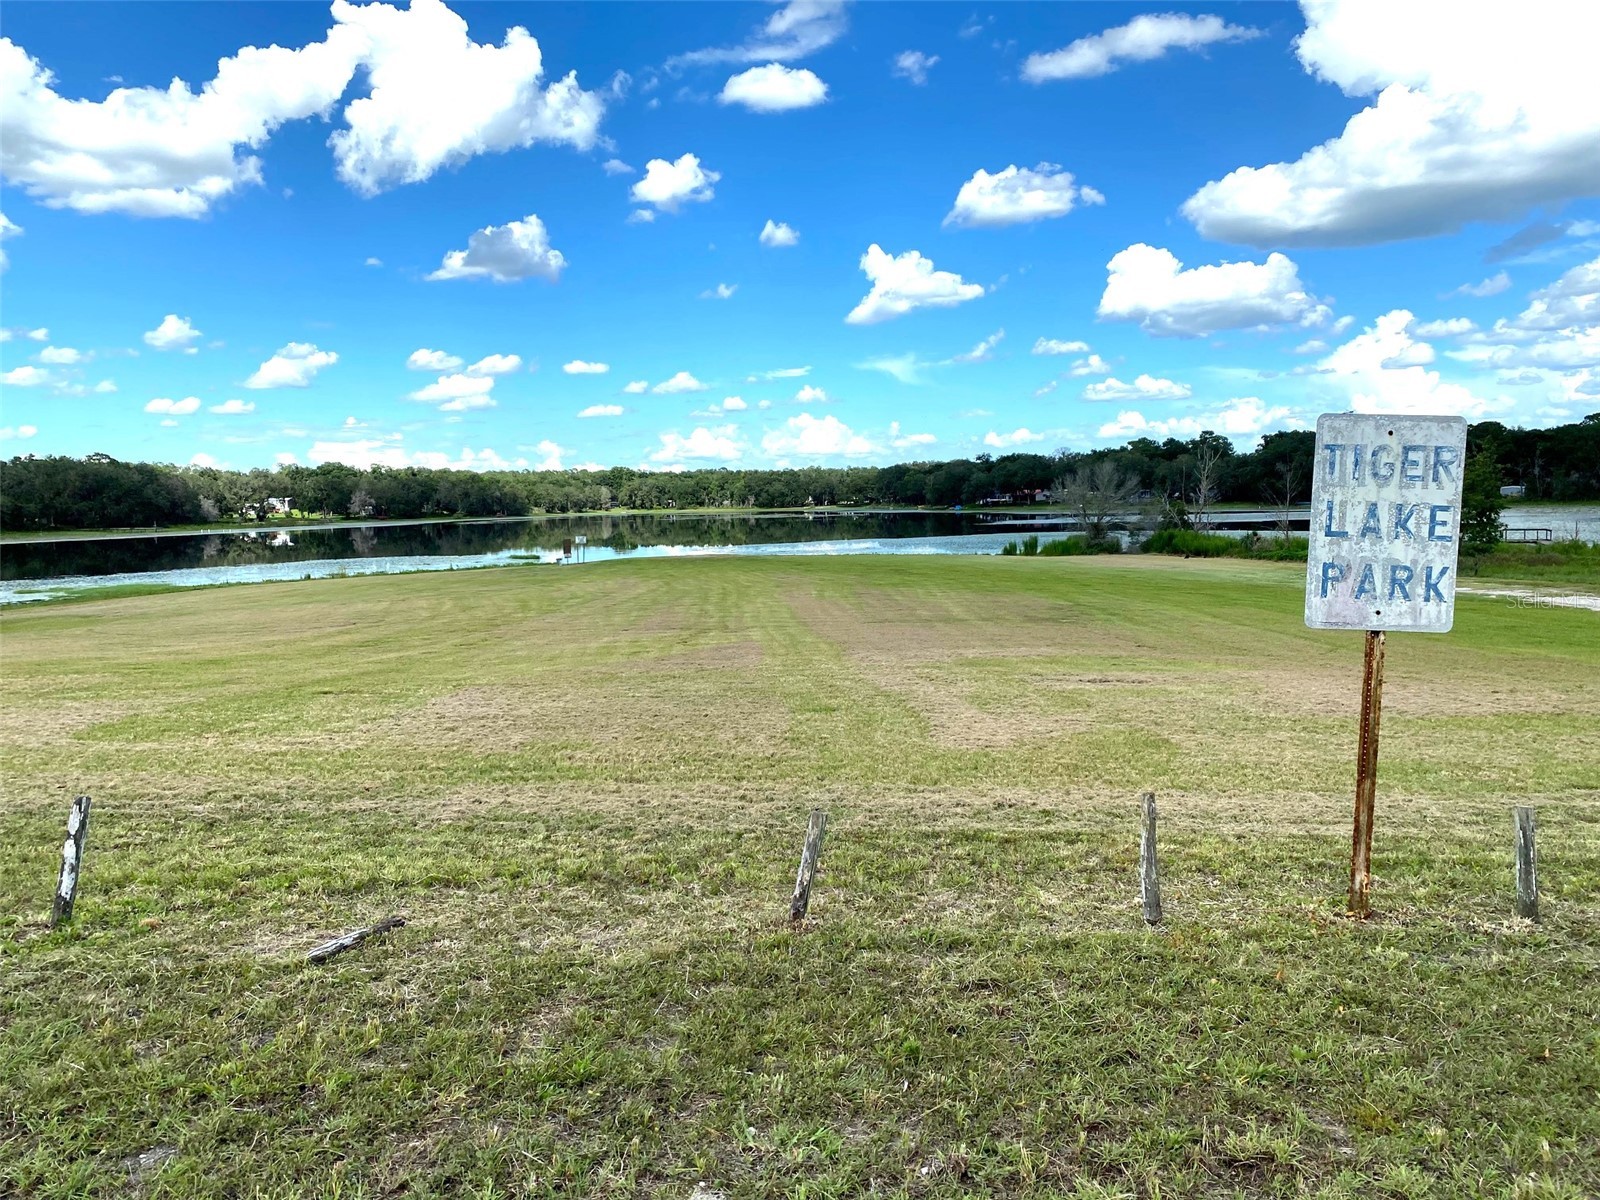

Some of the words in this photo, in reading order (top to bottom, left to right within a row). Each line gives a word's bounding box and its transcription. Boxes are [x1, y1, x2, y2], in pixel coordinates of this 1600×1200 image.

[1323, 443, 1459, 483] TIGER
[1324, 501, 1454, 542] LAKE
[1320, 561, 1450, 603] PARK
